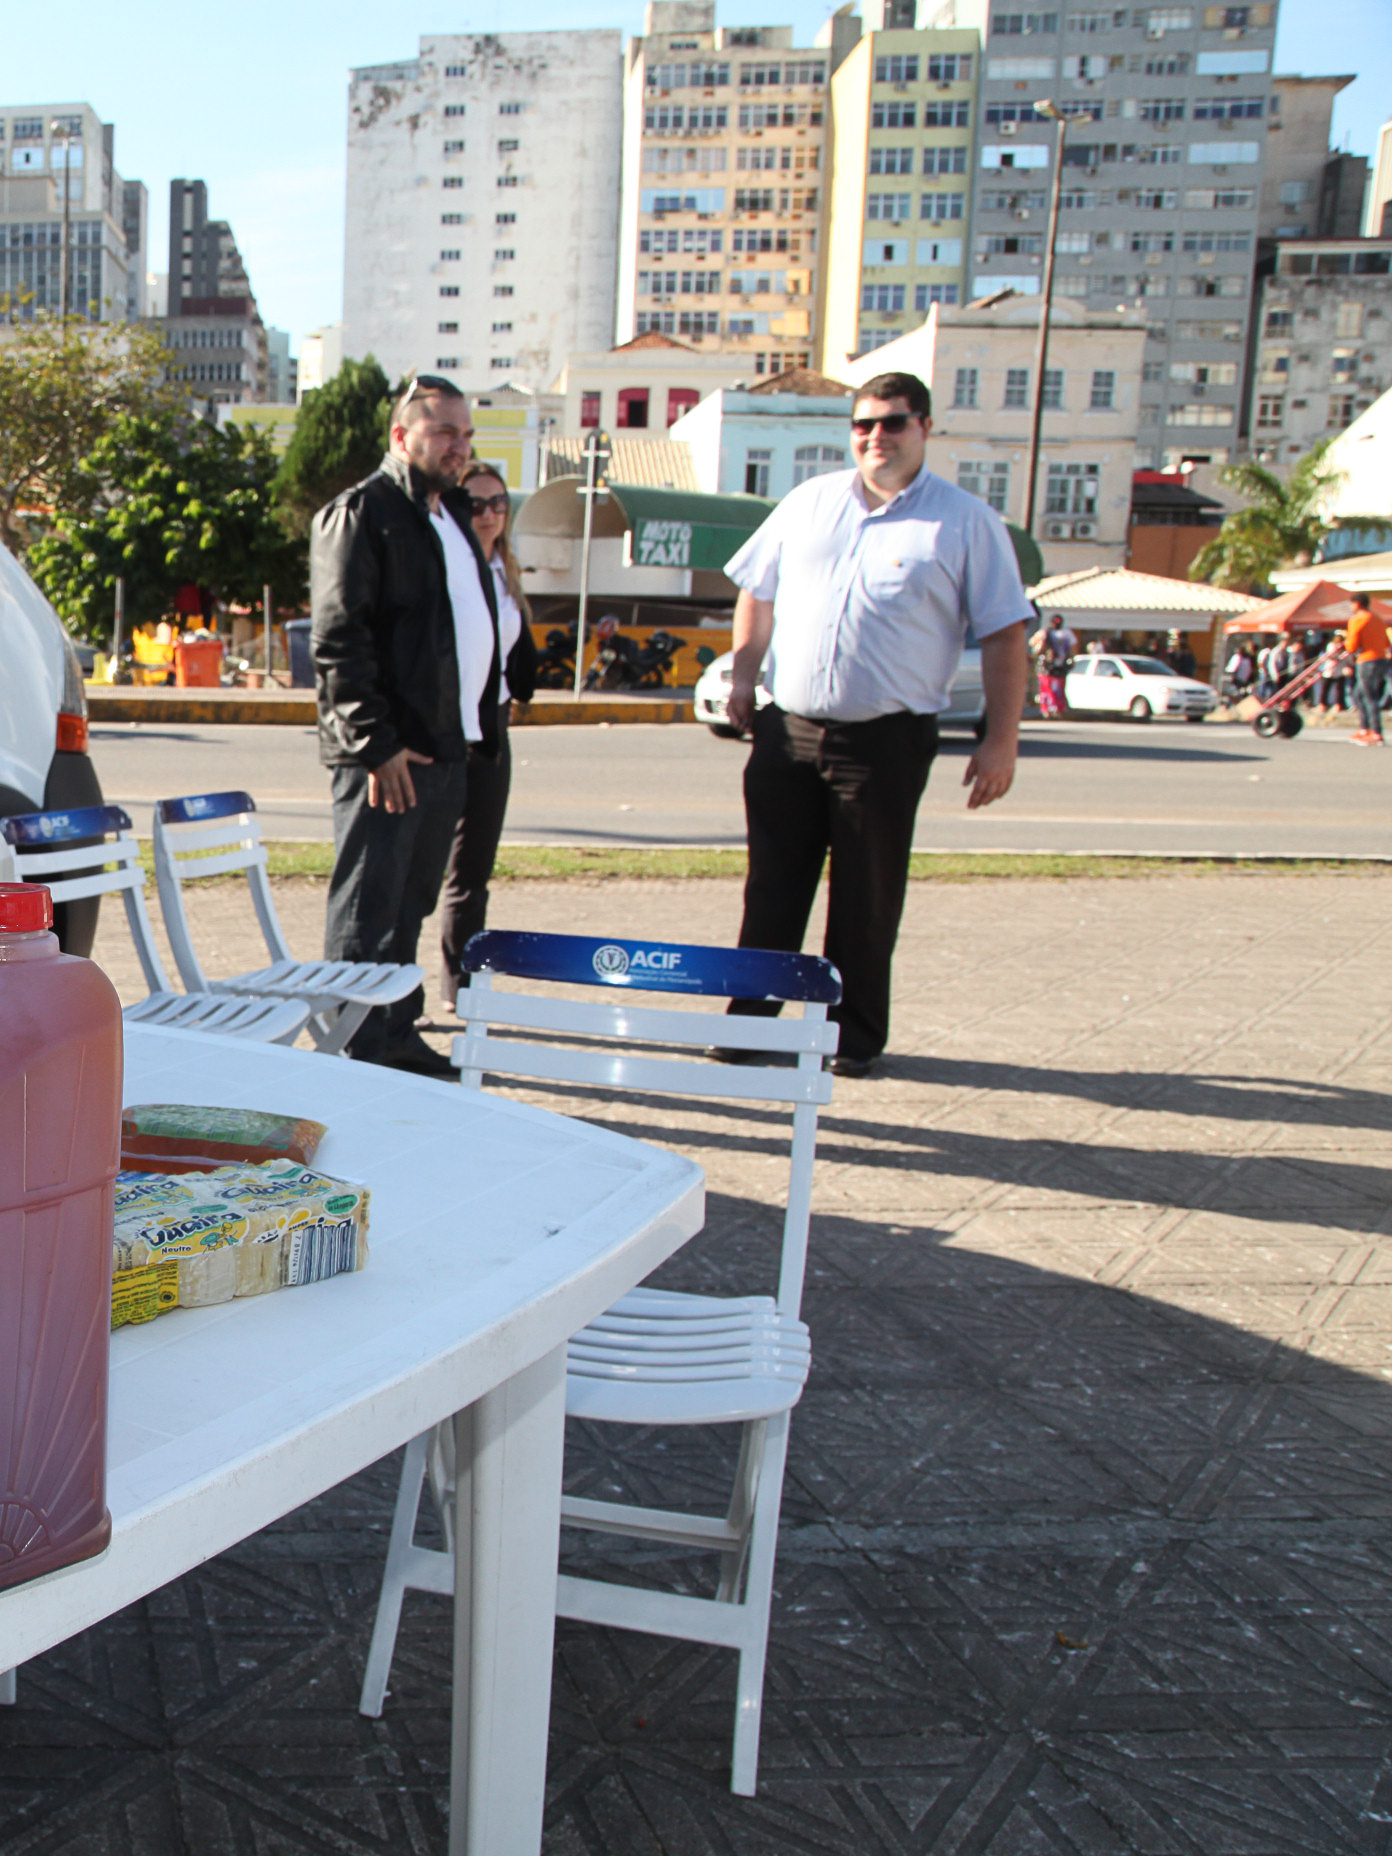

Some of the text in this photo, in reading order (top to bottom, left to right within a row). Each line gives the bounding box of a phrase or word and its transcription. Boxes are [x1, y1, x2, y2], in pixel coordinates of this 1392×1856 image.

[642, 520, 692, 541] MOTO
[639, 541, 690, 566] TAXI
[630, 950, 682, 969] ACIF
[161, 1246, 192, 1255] Neutro
